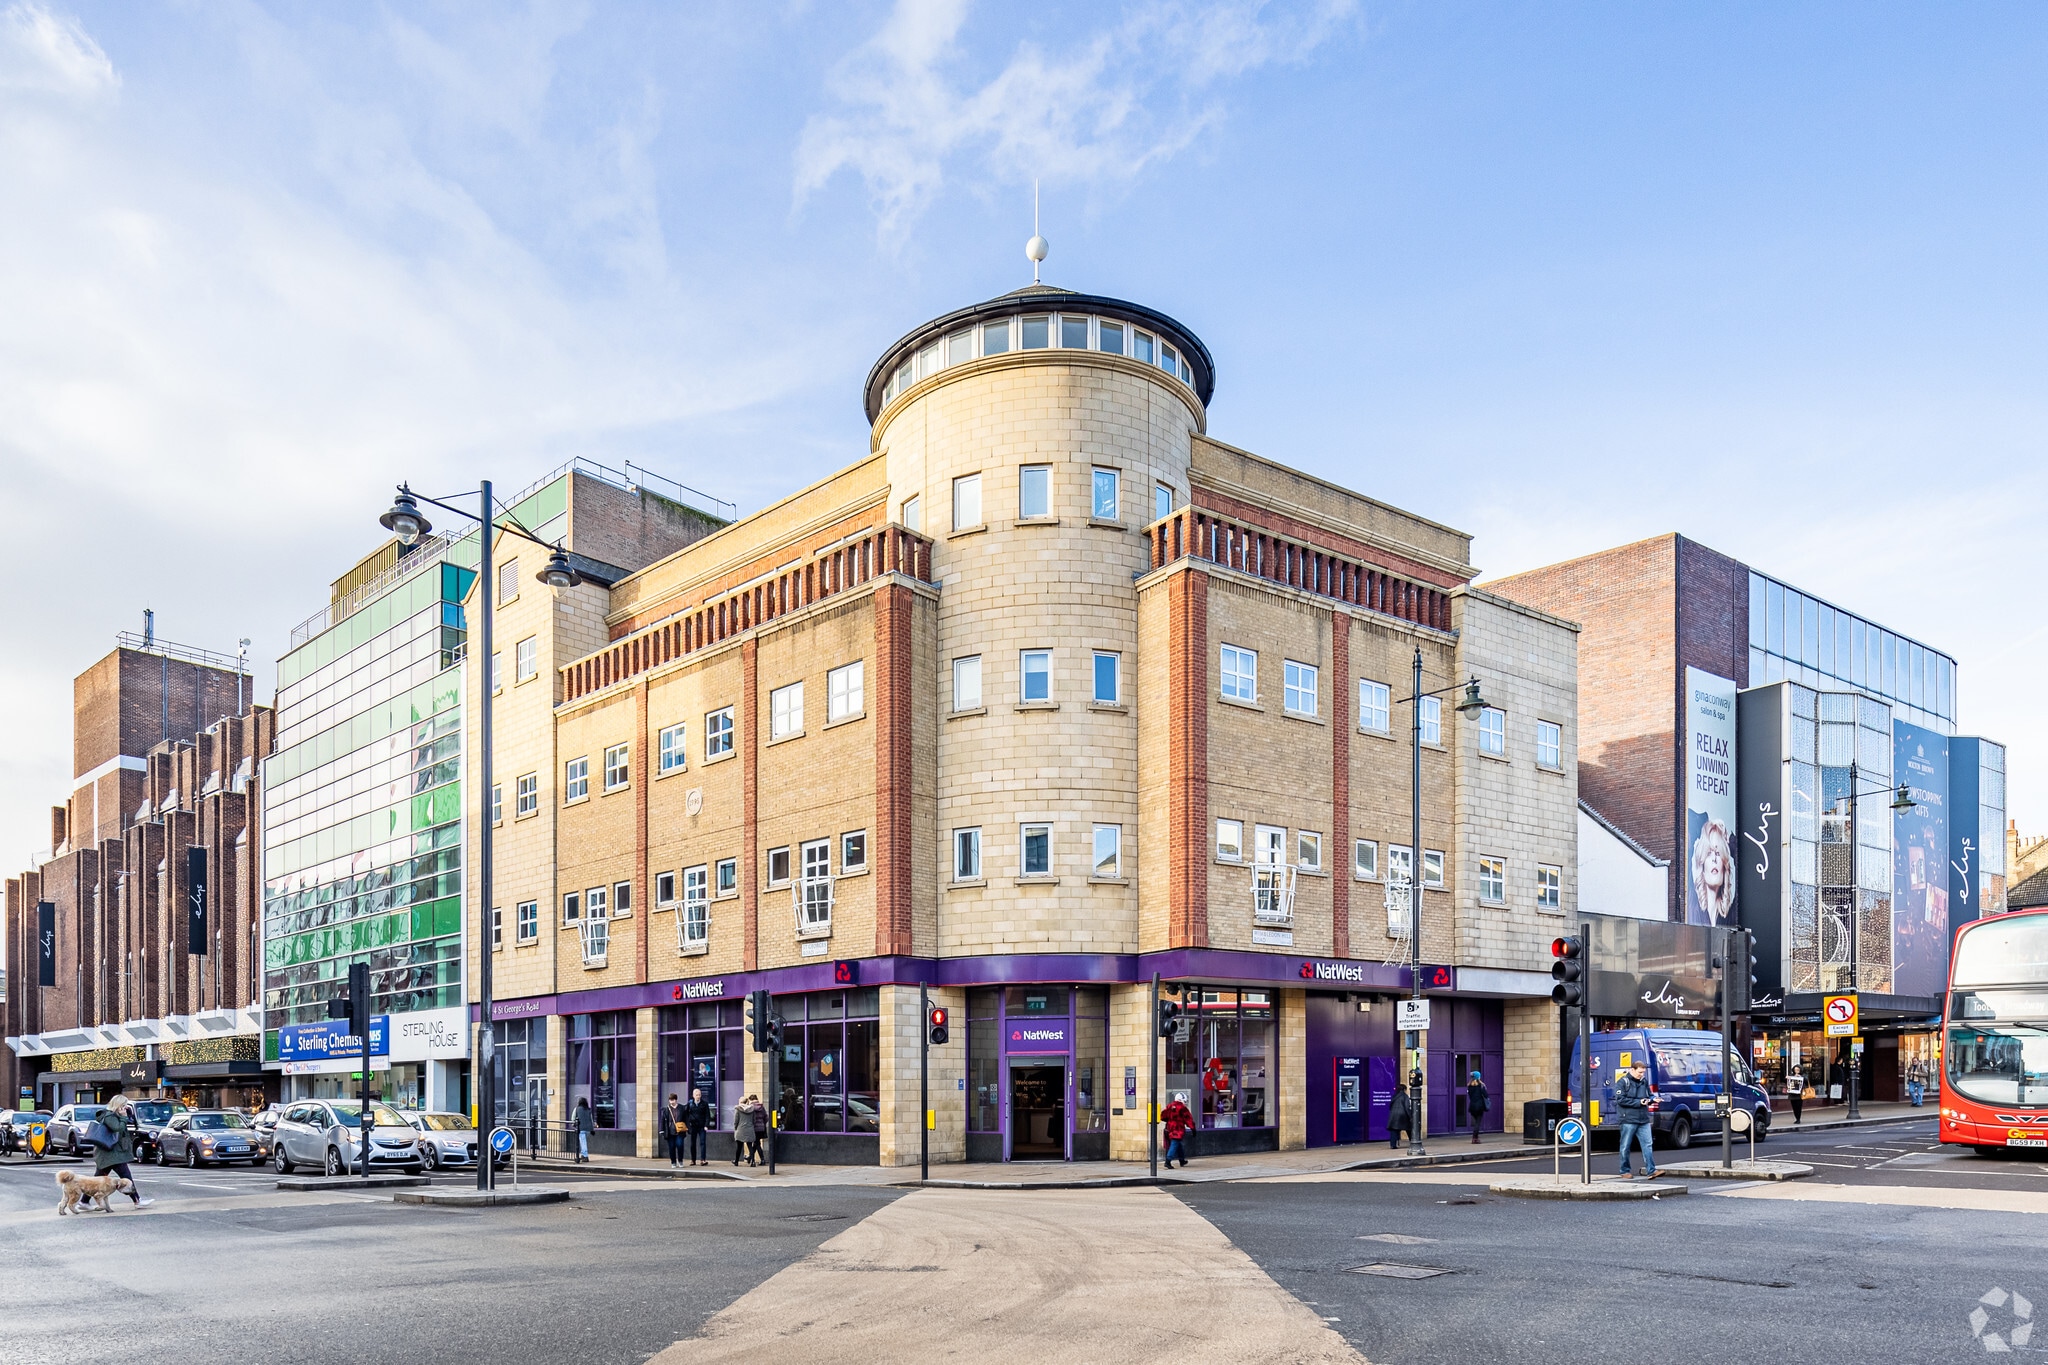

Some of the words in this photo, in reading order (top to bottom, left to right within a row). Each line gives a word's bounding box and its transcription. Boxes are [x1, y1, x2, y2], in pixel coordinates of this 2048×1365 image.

[1694, 689, 1731, 712] ginaconway
[1700, 705, 1713, 717] salon
[1713, 709, 1717, 718] &
[1717, 712, 1726, 721] spa
[1696, 732, 1729, 758] RELAX
[1696, 754, 1729, 777] UNWIND
[1696, 773, 1730, 797] REPEAT
[1914, 804, 1929, 818] GIFTS
[1744, 802, 1779, 880] elys
[1951, 837, 1976, 905] elys
[190, 884, 206, 919] elys
[40, 930, 54, 959] elys
[1316, 963, 1363, 982] NatWest
[683, 981, 724, 999] NatWest
[1641, 980, 1685, 1014] elys
[504, 1003, 526, 1015] George's
[526, 1002, 540, 1012] Road
[369, 1029, 382, 1040] NHS
[402, 1021, 444, 1037] STERLING
[1023, 1030, 1064, 1040] NatWest
[298, 1034, 328, 1052] Sterling
[429, 1033, 458, 1048] HOUSE
[2008, 1128, 2027, 1139] Go
